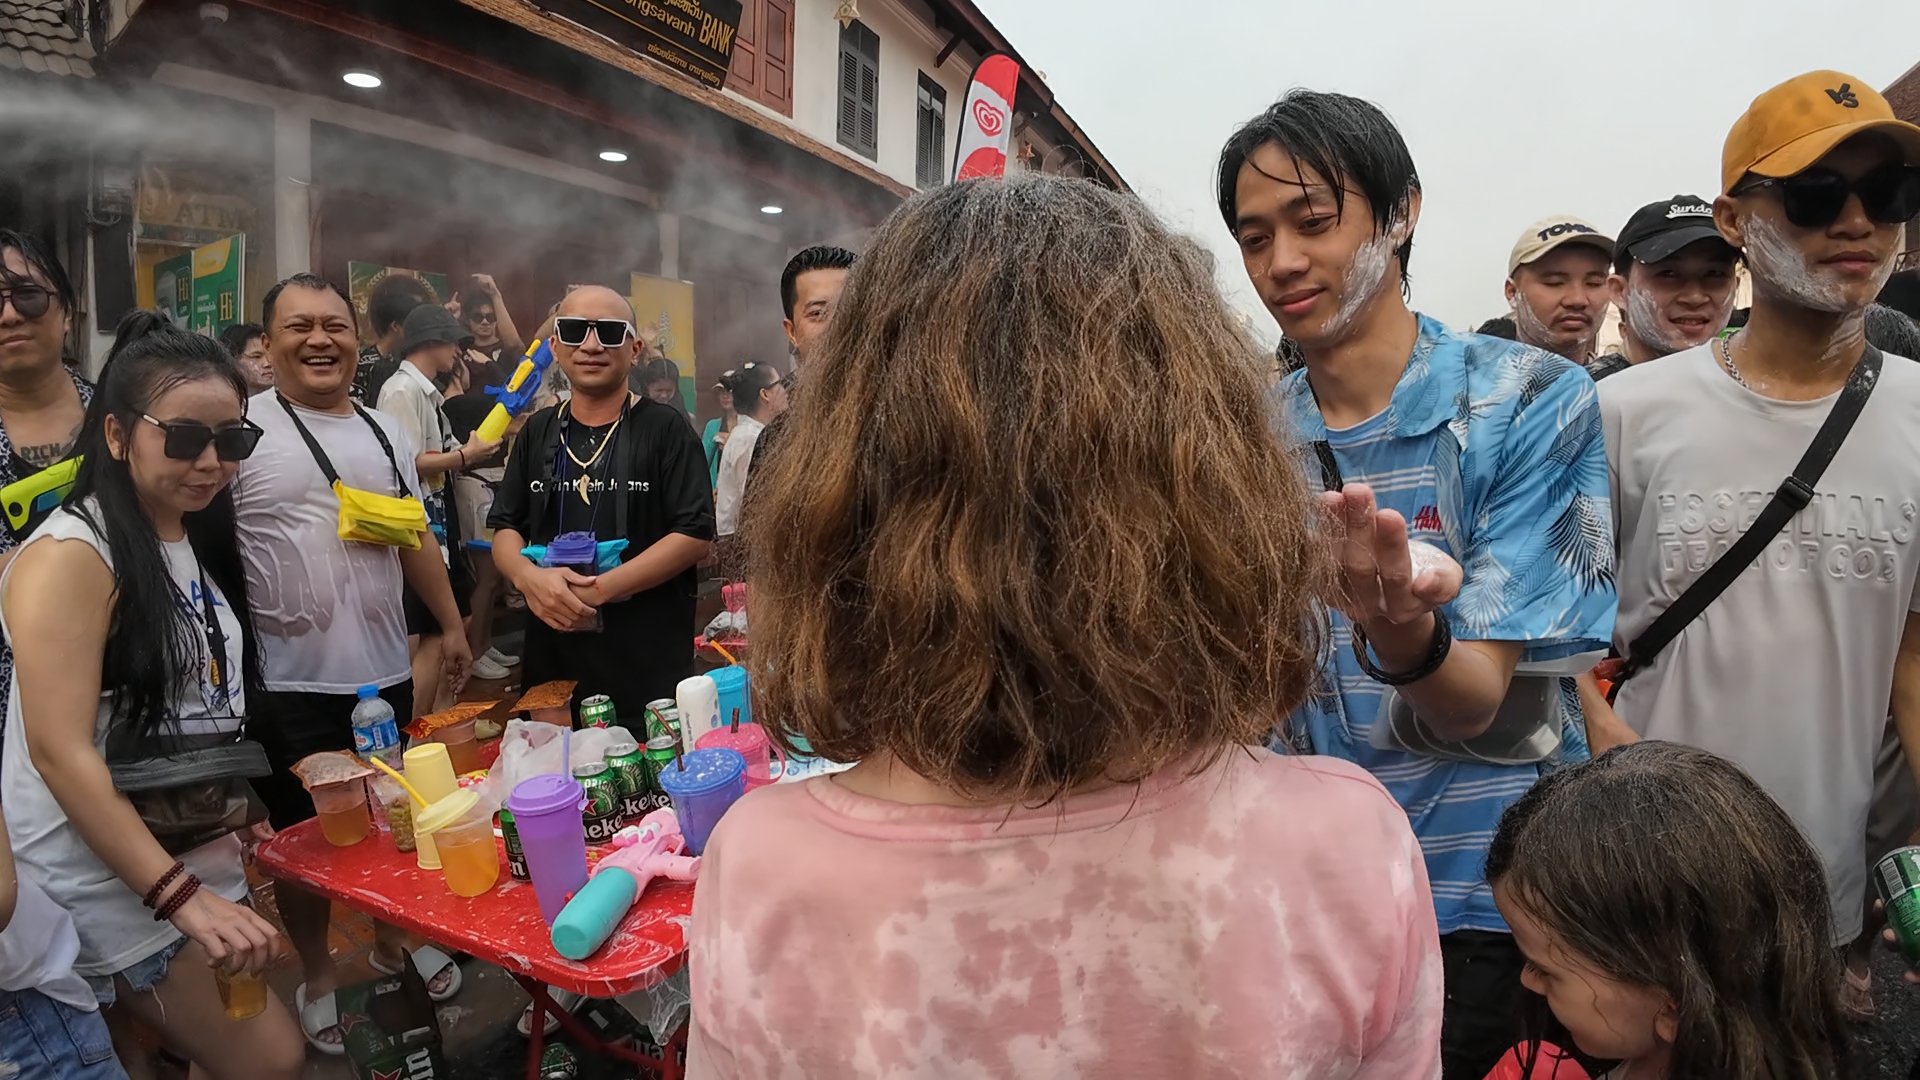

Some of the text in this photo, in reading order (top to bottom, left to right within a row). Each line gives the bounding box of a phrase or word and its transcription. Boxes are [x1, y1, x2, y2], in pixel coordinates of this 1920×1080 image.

[699, 12, 735, 57] BANK
[220, 291, 233, 320] Hi
[20, 443, 60, 461] RICH
[530, 480, 570, 492] Cin
[572, 478, 604, 492] Kein
[1657, 491, 1916, 544] ESSETIALS
[1663, 540, 1897, 583] FE OF GOD
